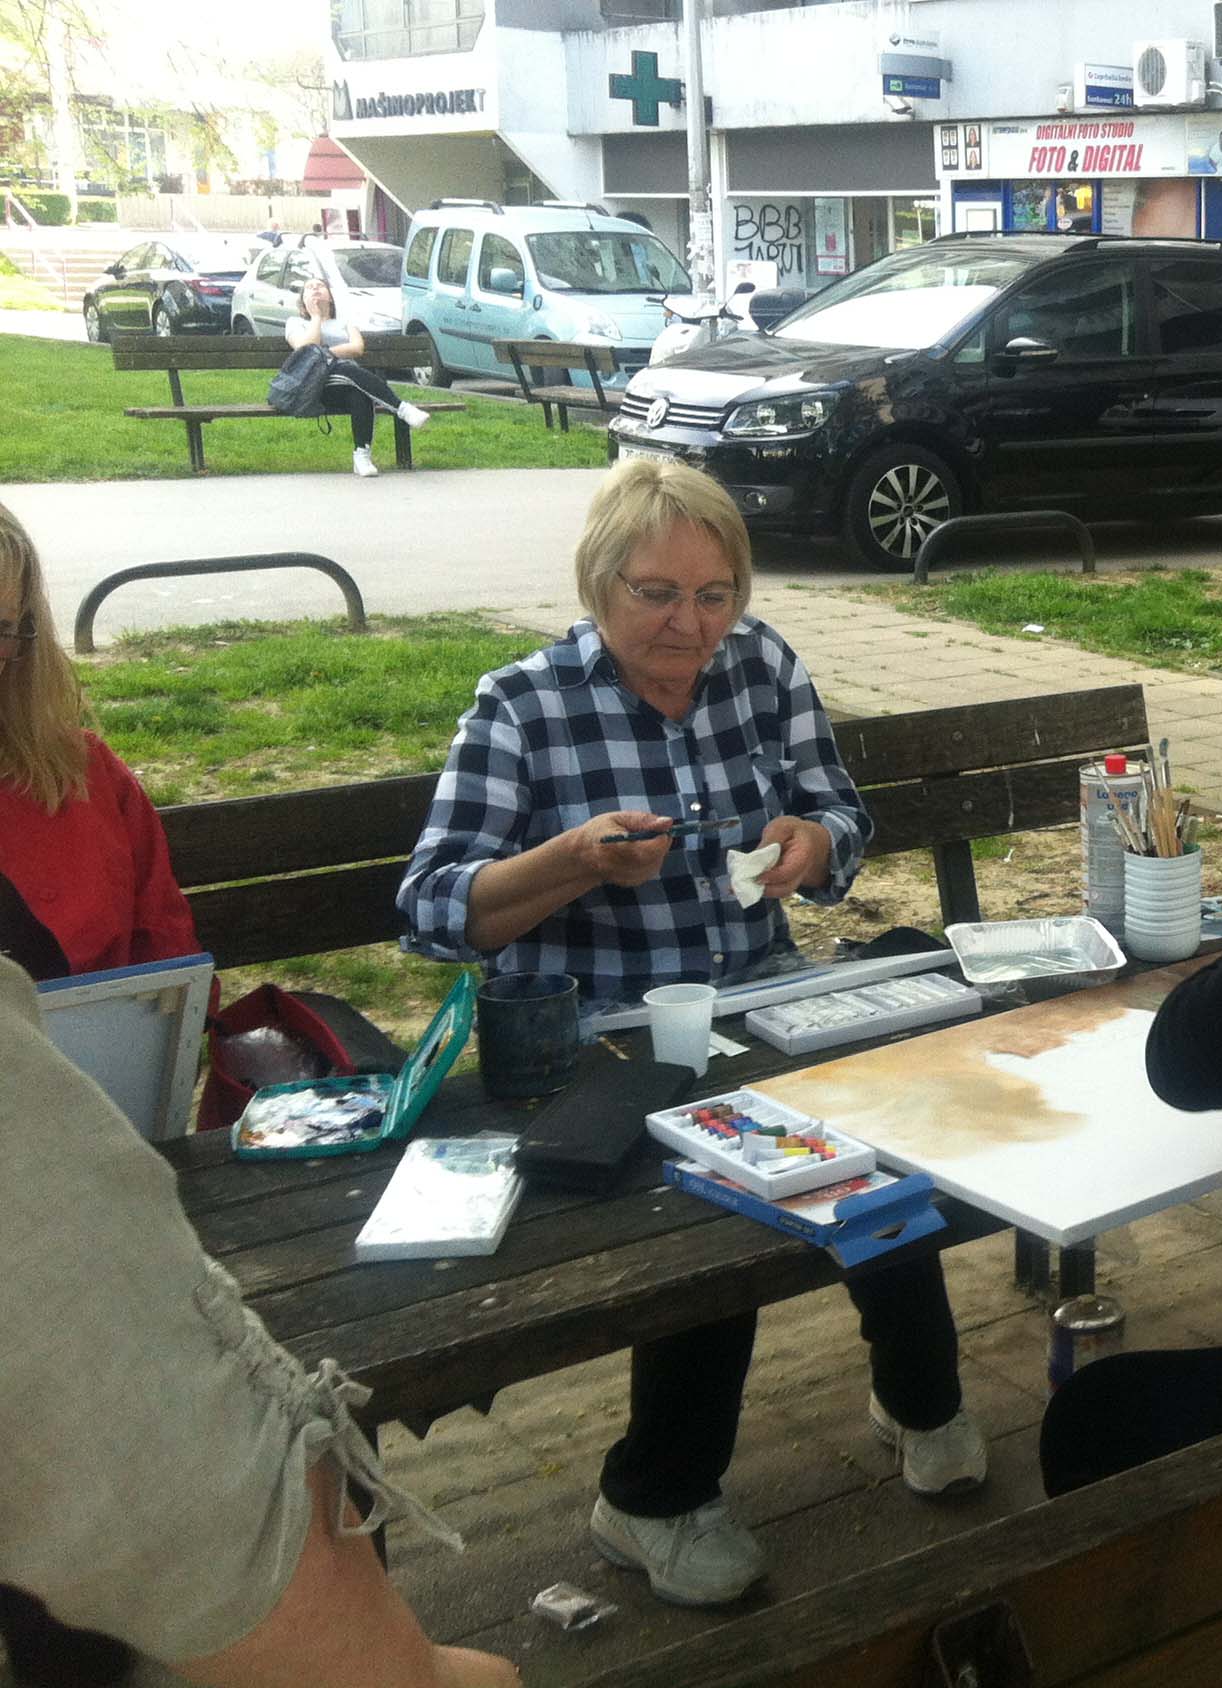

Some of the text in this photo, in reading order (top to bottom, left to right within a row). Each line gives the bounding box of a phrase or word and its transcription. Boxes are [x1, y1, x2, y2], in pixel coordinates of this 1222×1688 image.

[1114, 93, 1132, 105] 24h
[1036, 123, 1078, 140] DIGITALNI
[1076, 122, 1100, 139] FOTO
[1100, 121, 1135, 139] STUDIO
[1028, 143, 1144, 173] FOTO & DIGITAL
[734, 204, 801, 243] BBB
